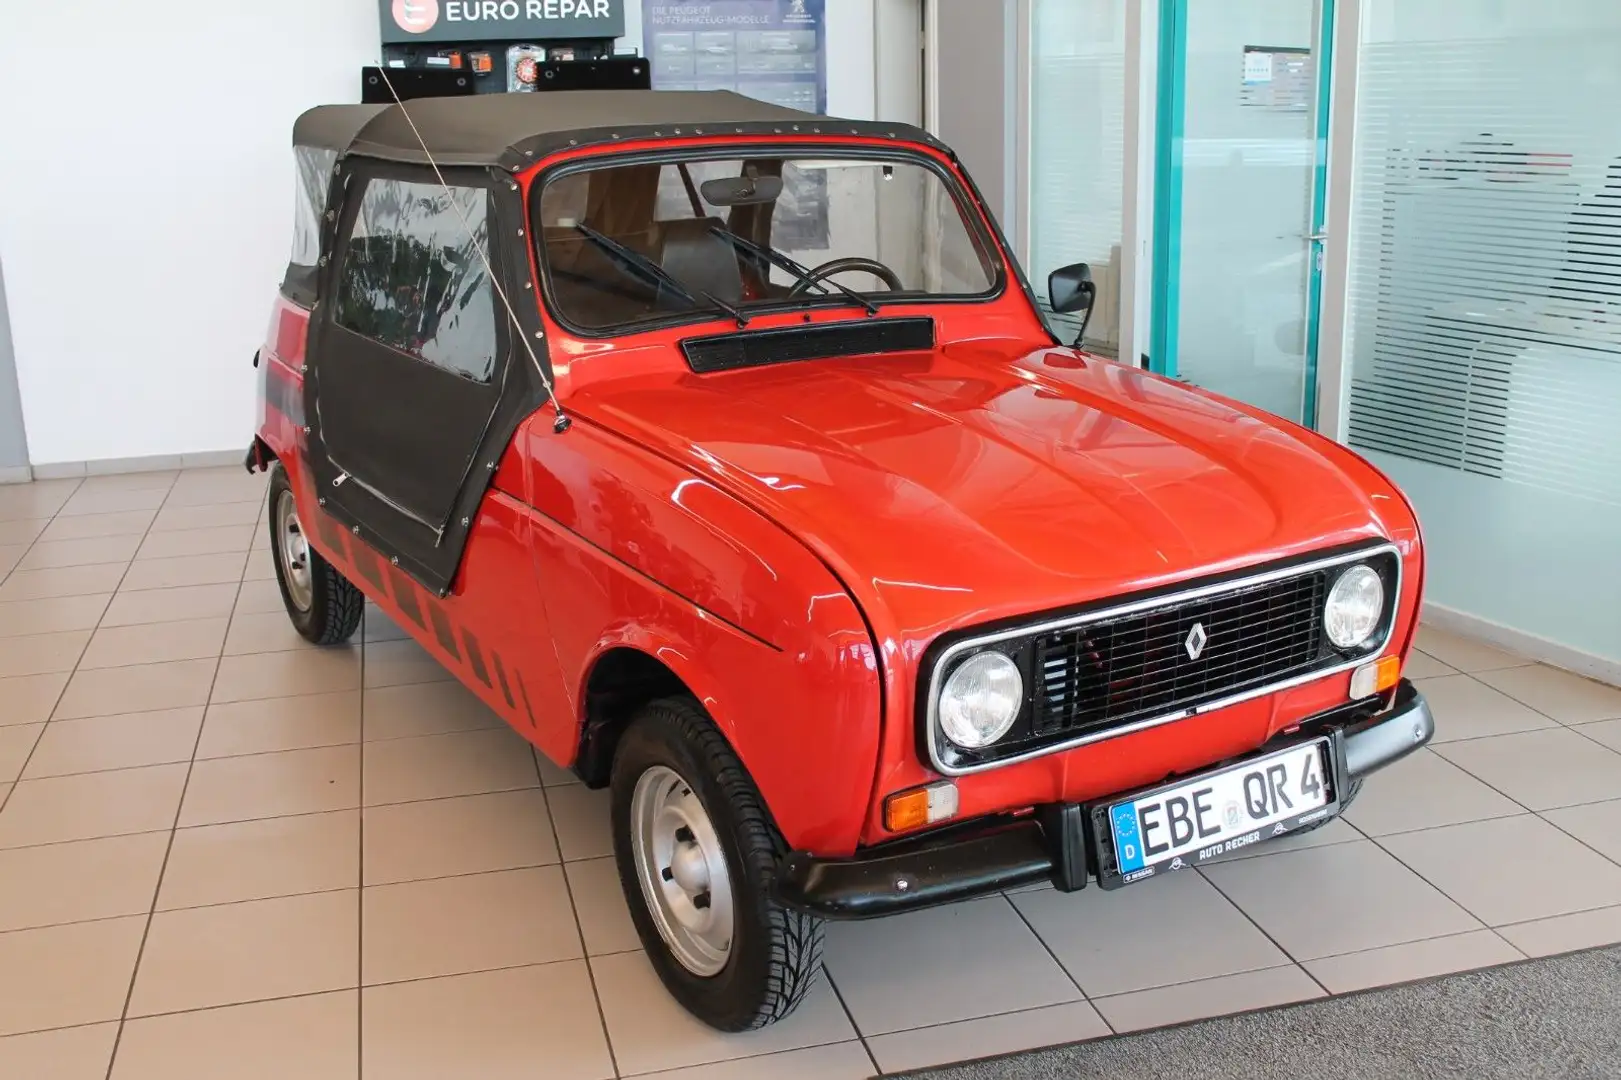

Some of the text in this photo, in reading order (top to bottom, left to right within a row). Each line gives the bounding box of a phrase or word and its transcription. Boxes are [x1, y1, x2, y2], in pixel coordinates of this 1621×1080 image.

[446, 0, 610, 21] EURO REPAR
[669, 5, 711, 15] PEUGEOT
[1138, 753, 1320, 857] EBE QR 4
[1124, 844, 1135, 860] D
[1199, 831, 1260, 861] AUTO RECHER
